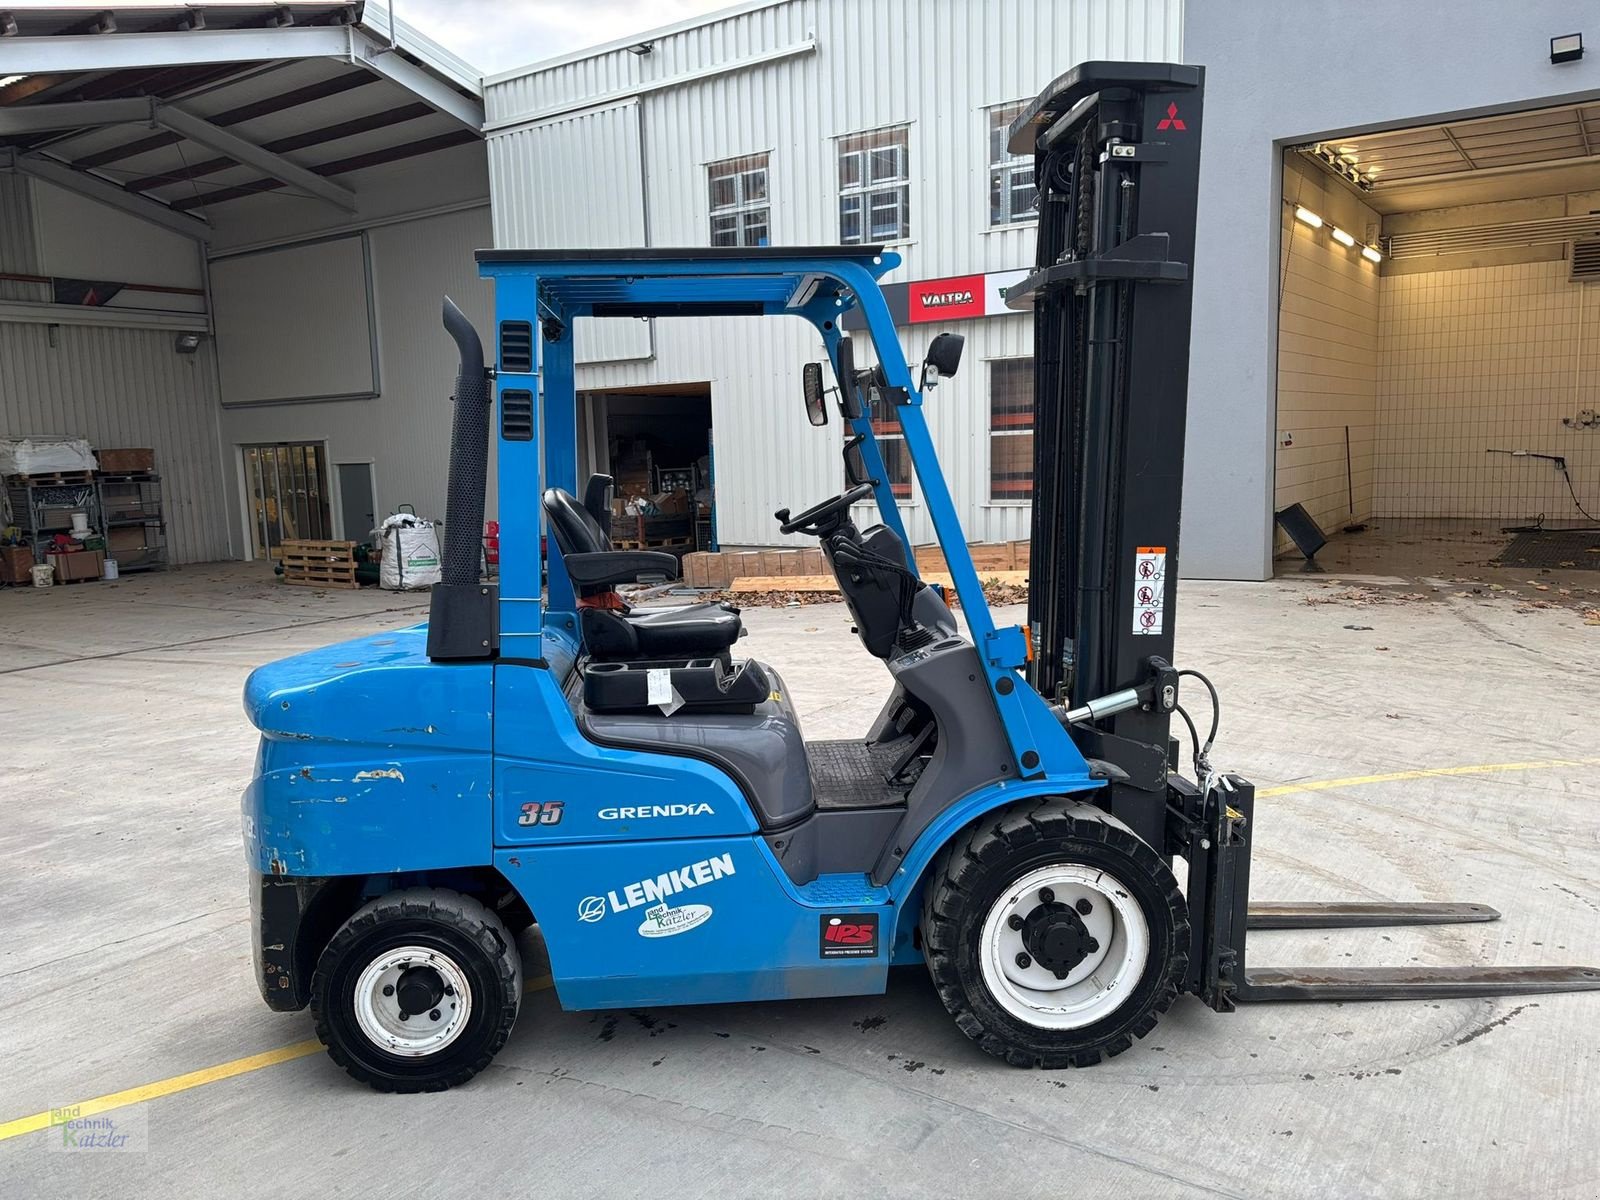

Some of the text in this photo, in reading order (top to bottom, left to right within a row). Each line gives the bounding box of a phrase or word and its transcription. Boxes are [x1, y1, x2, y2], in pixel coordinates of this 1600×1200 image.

[919, 290, 974, 308] VALTRA
[517, 800, 566, 827] 35
[607, 852, 736, 914] LEMKEN
[657, 911, 697, 929] Katzler
